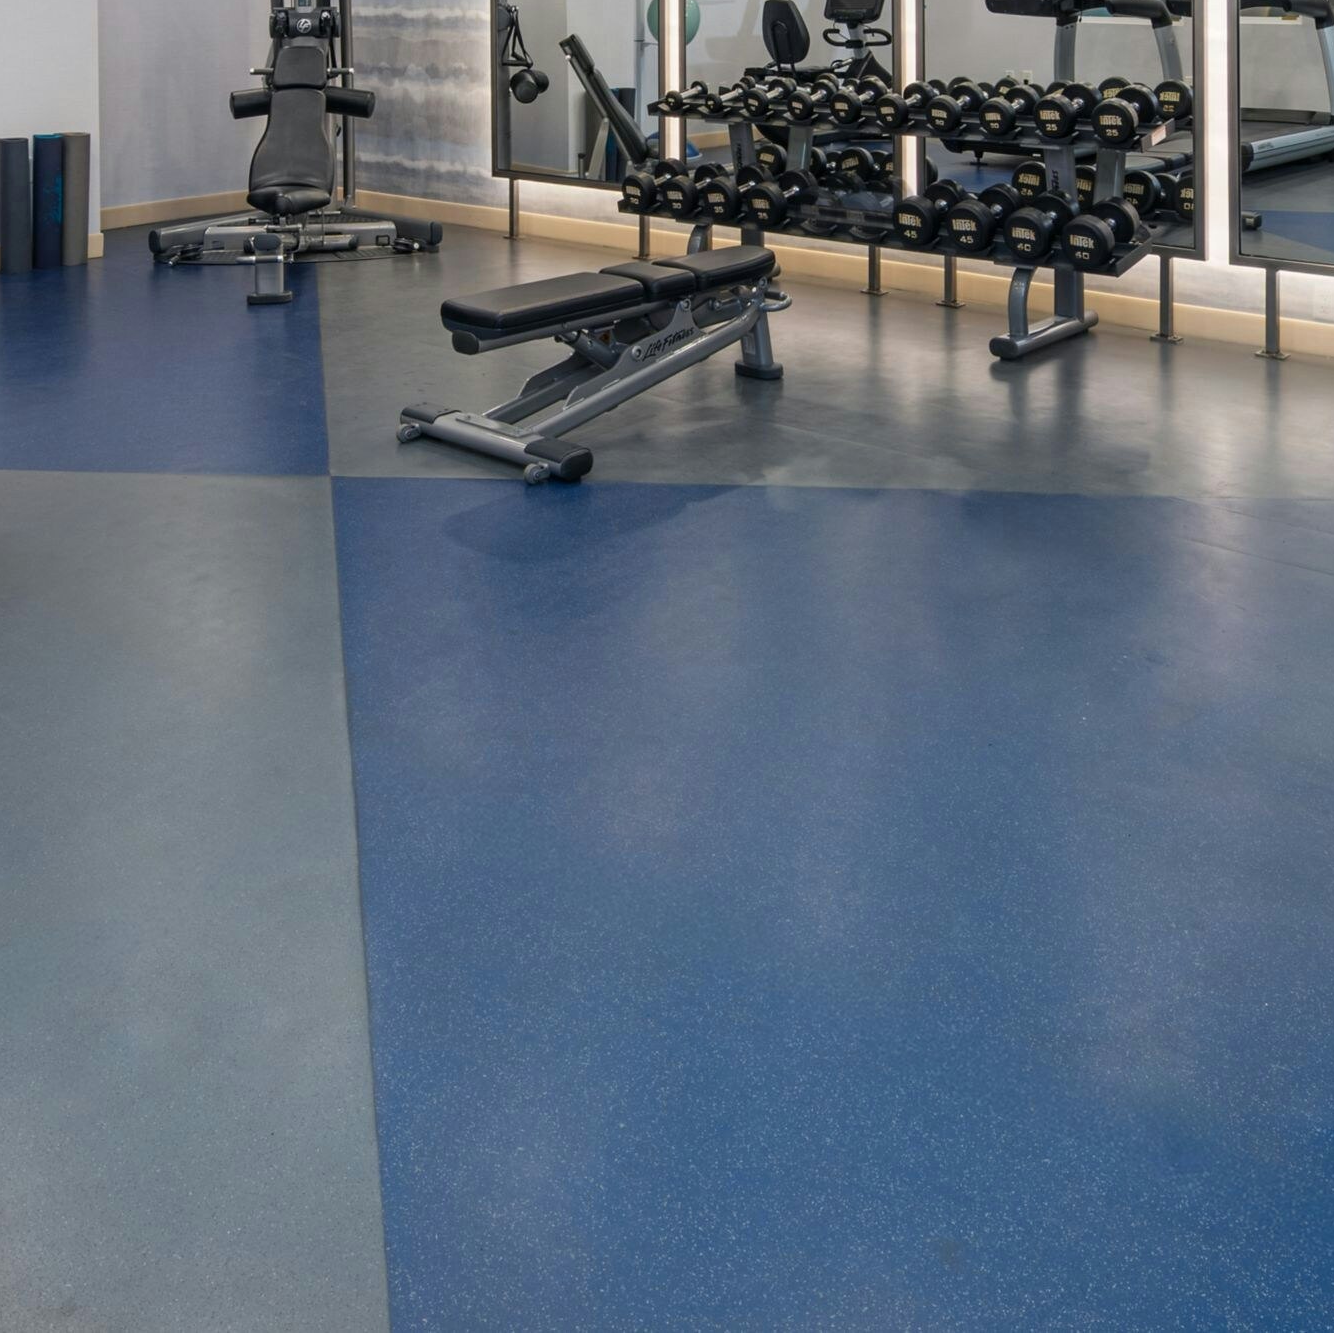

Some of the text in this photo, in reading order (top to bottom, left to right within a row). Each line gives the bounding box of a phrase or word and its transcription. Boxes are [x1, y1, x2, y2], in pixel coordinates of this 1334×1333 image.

[1046, 123, 1057, 131] 25
[1106, 129, 1119, 137] 25
[904, 229, 917, 239] 45
[960, 235, 974, 244] 45
